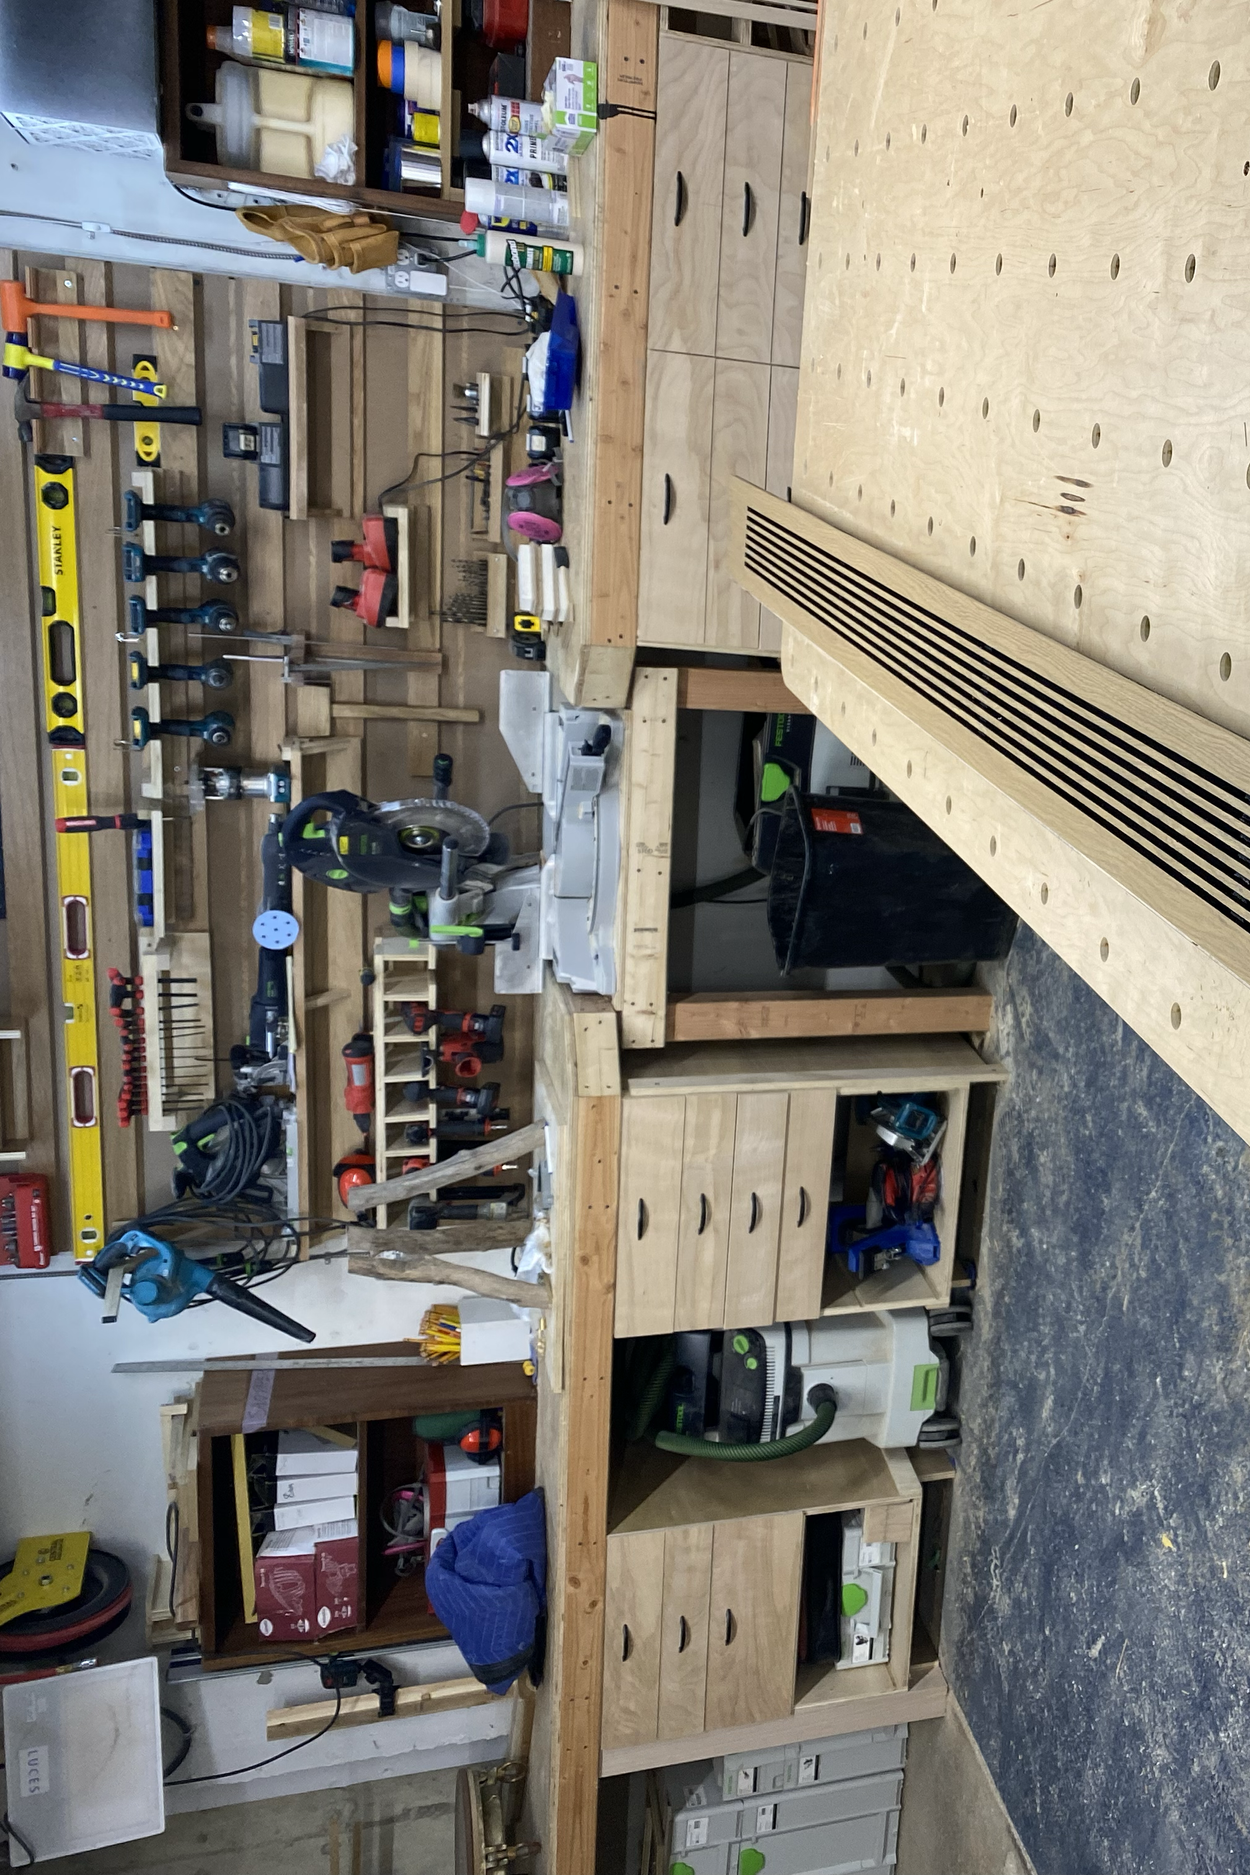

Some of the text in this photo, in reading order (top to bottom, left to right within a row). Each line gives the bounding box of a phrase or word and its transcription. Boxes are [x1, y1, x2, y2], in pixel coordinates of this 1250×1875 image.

[505, 133, 518, 153] 2X
[51, 525, 63, 575] STANLEY
[774, 713, 785, 747] FESTOO
[27, 1749, 40, 1794] LUCES
